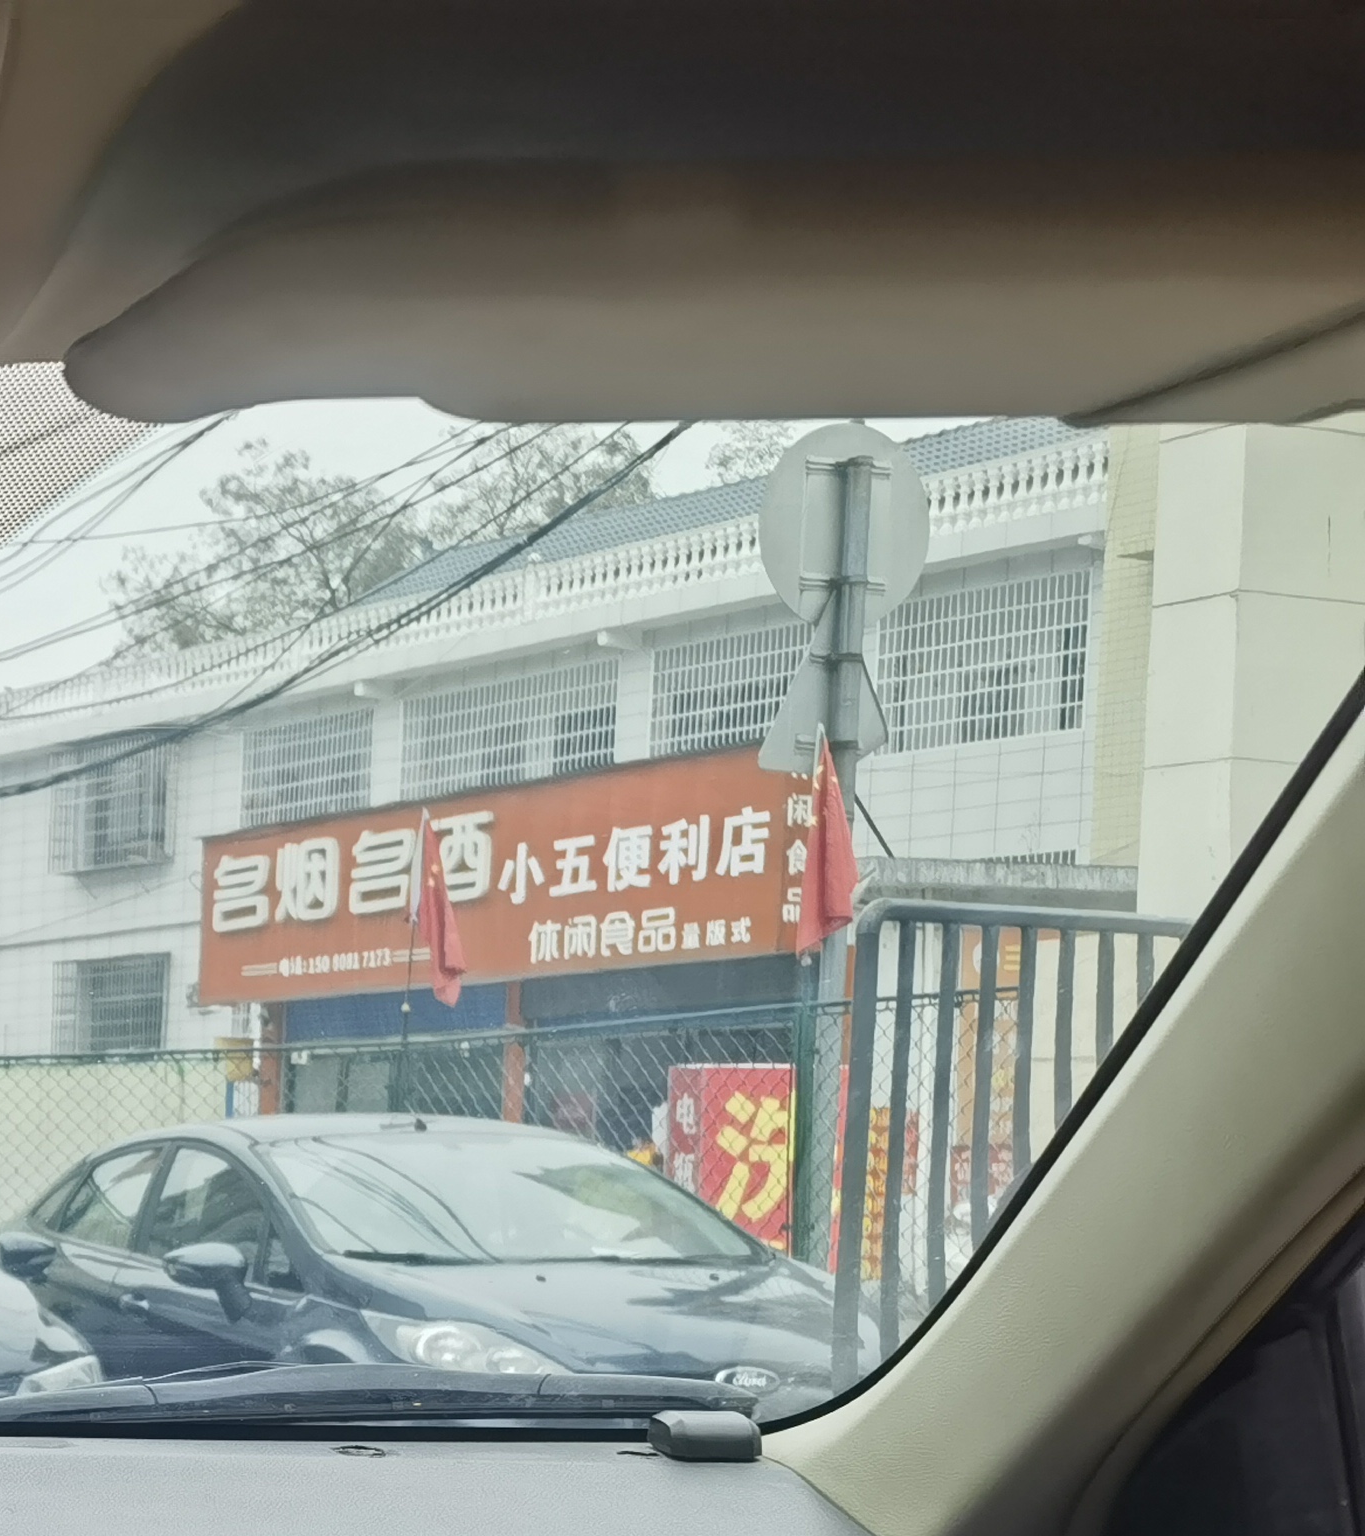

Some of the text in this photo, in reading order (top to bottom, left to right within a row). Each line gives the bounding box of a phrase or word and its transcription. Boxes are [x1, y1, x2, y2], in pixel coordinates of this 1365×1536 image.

[212, 810, 493, 932] 名烟名酒
[497, 806, 771, 904] 小五便利店
[782, 771, 813, 923] 闲食品
[528, 906, 676, 964] 休闲食品
